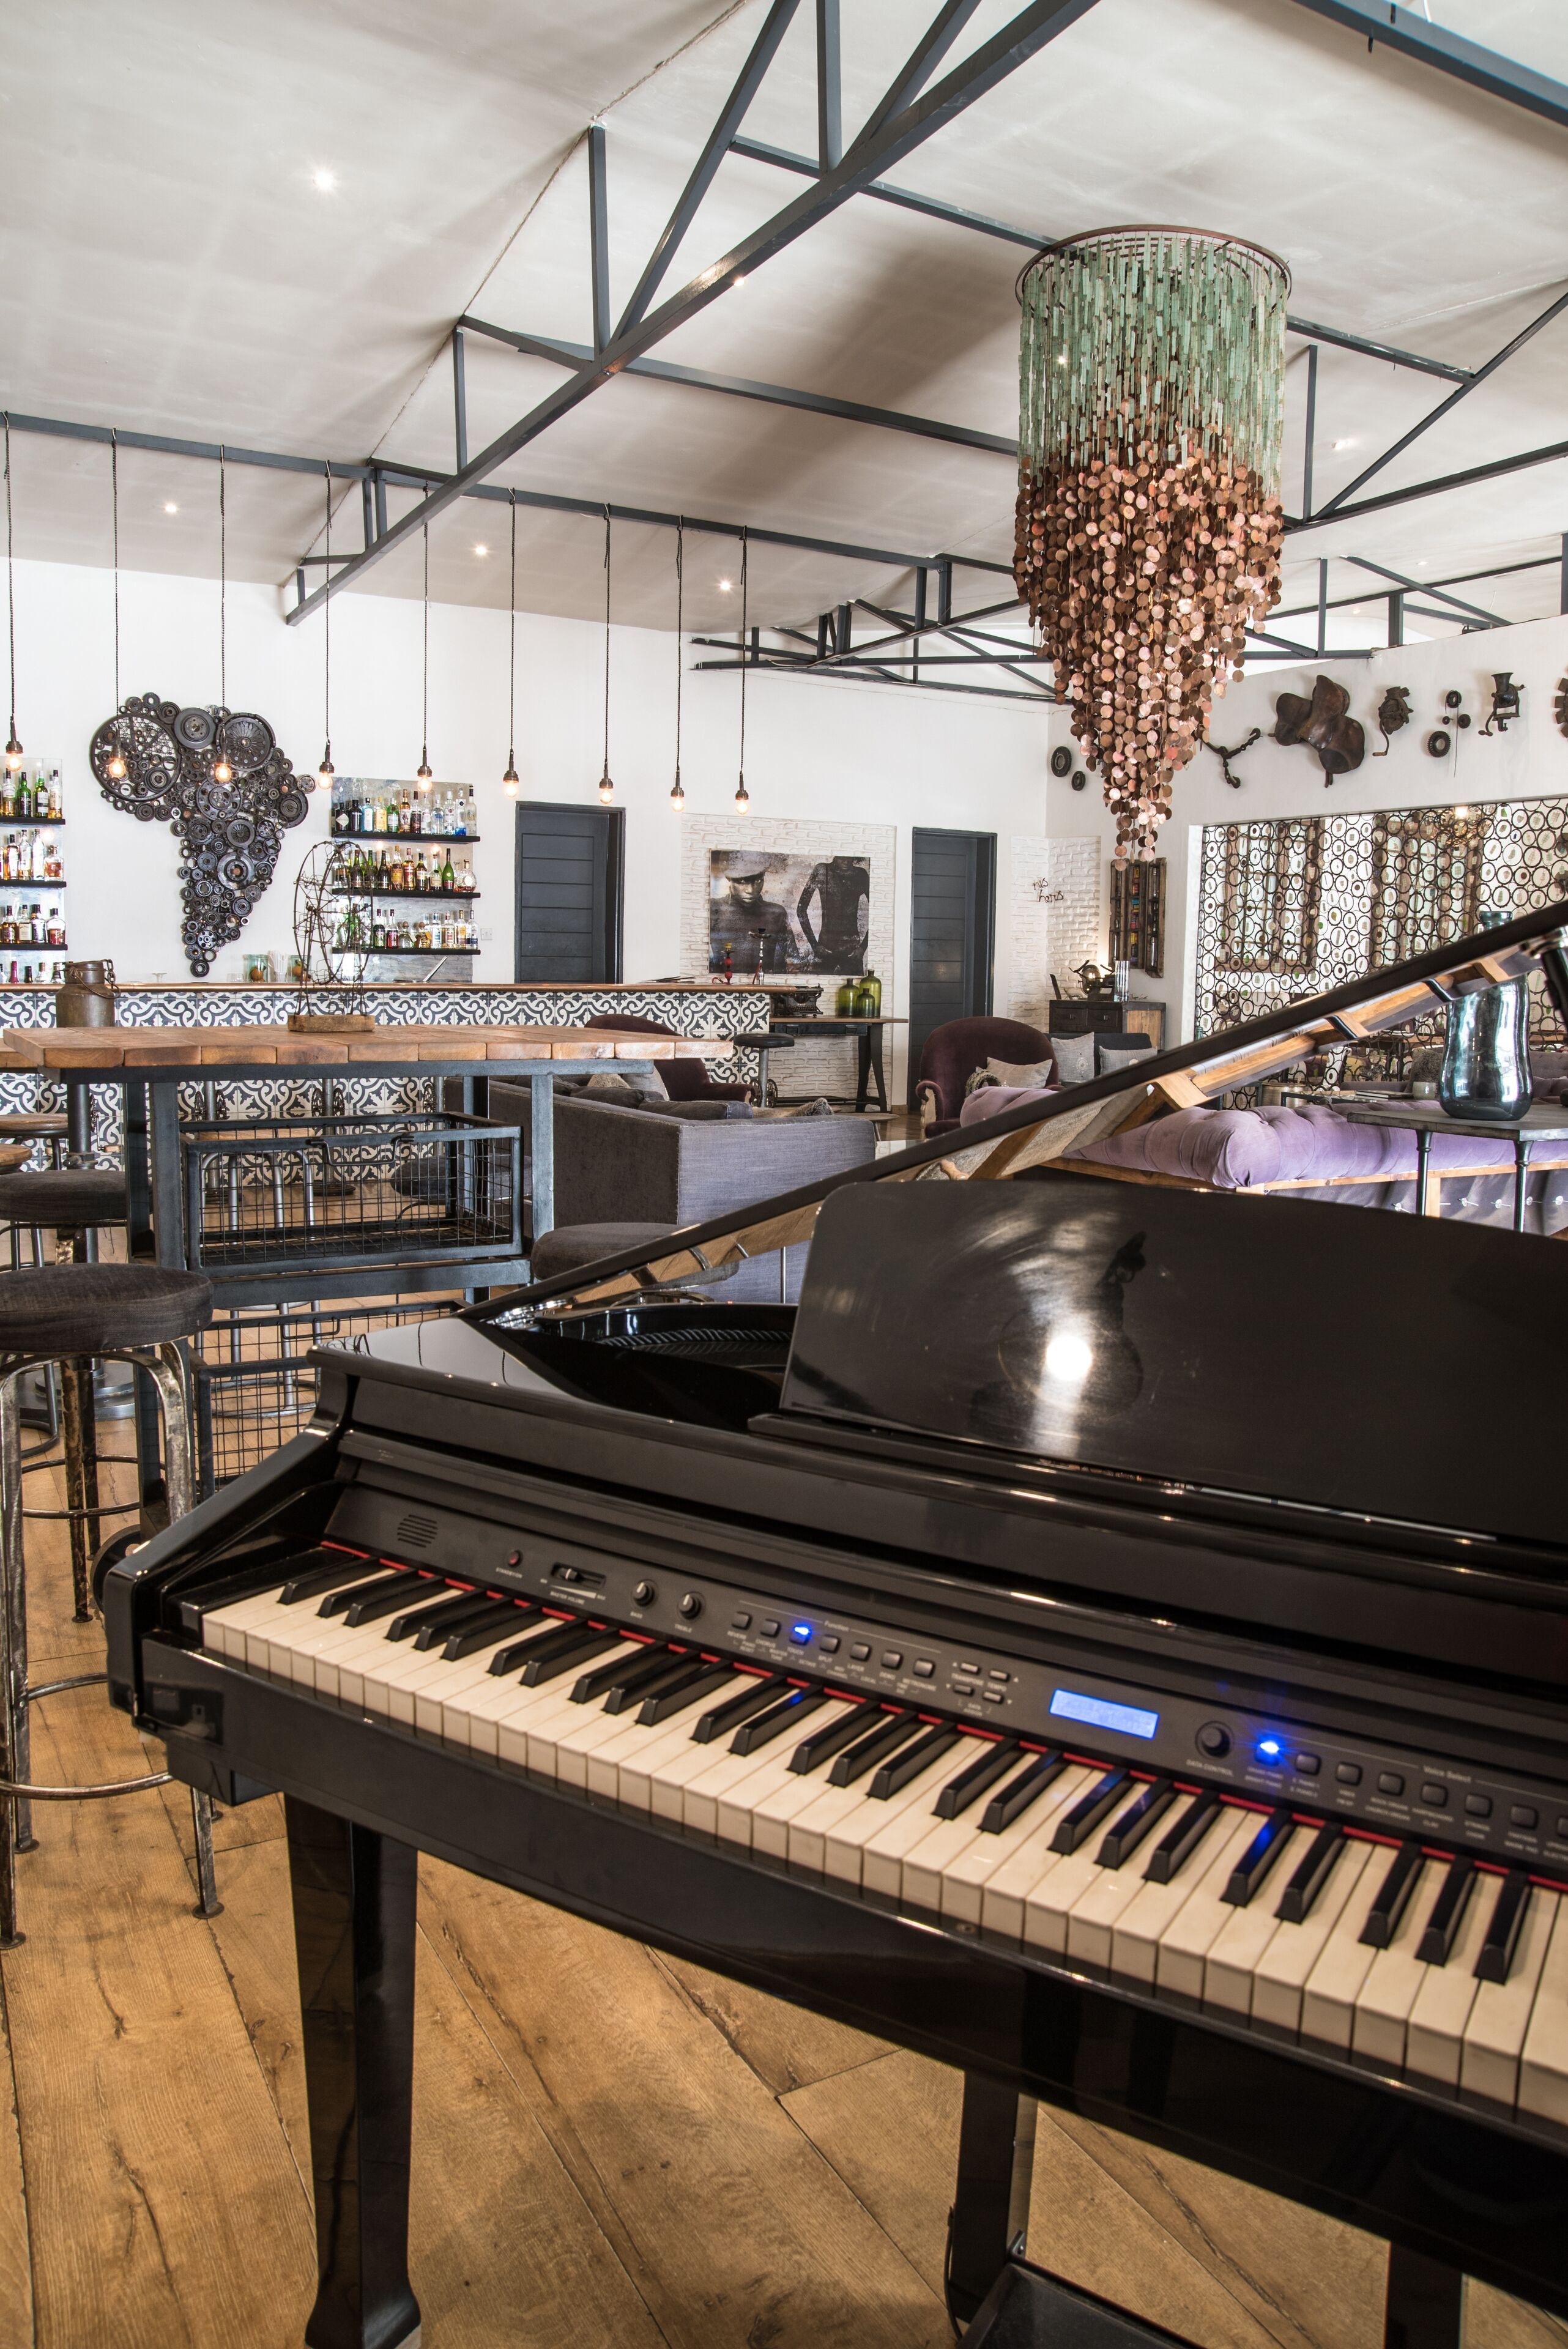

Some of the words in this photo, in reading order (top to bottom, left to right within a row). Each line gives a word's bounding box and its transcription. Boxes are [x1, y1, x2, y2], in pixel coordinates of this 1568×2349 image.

[1038, 889, 1064, 903] hers
[550, 1591, 567, 1600] MASTER
[568, 1595, 585, 1605] VOLUME
[824, 1620, 849, 1631] Function
[847, 1663, 865, 1672] LAYER
[1186, 1759, 1203, 1768] DATA
[1203, 1763, 1234, 1776] CONTROL
[1423, 1765, 1445, 1777] Voice
[1446, 1770, 1471, 1783] Select
